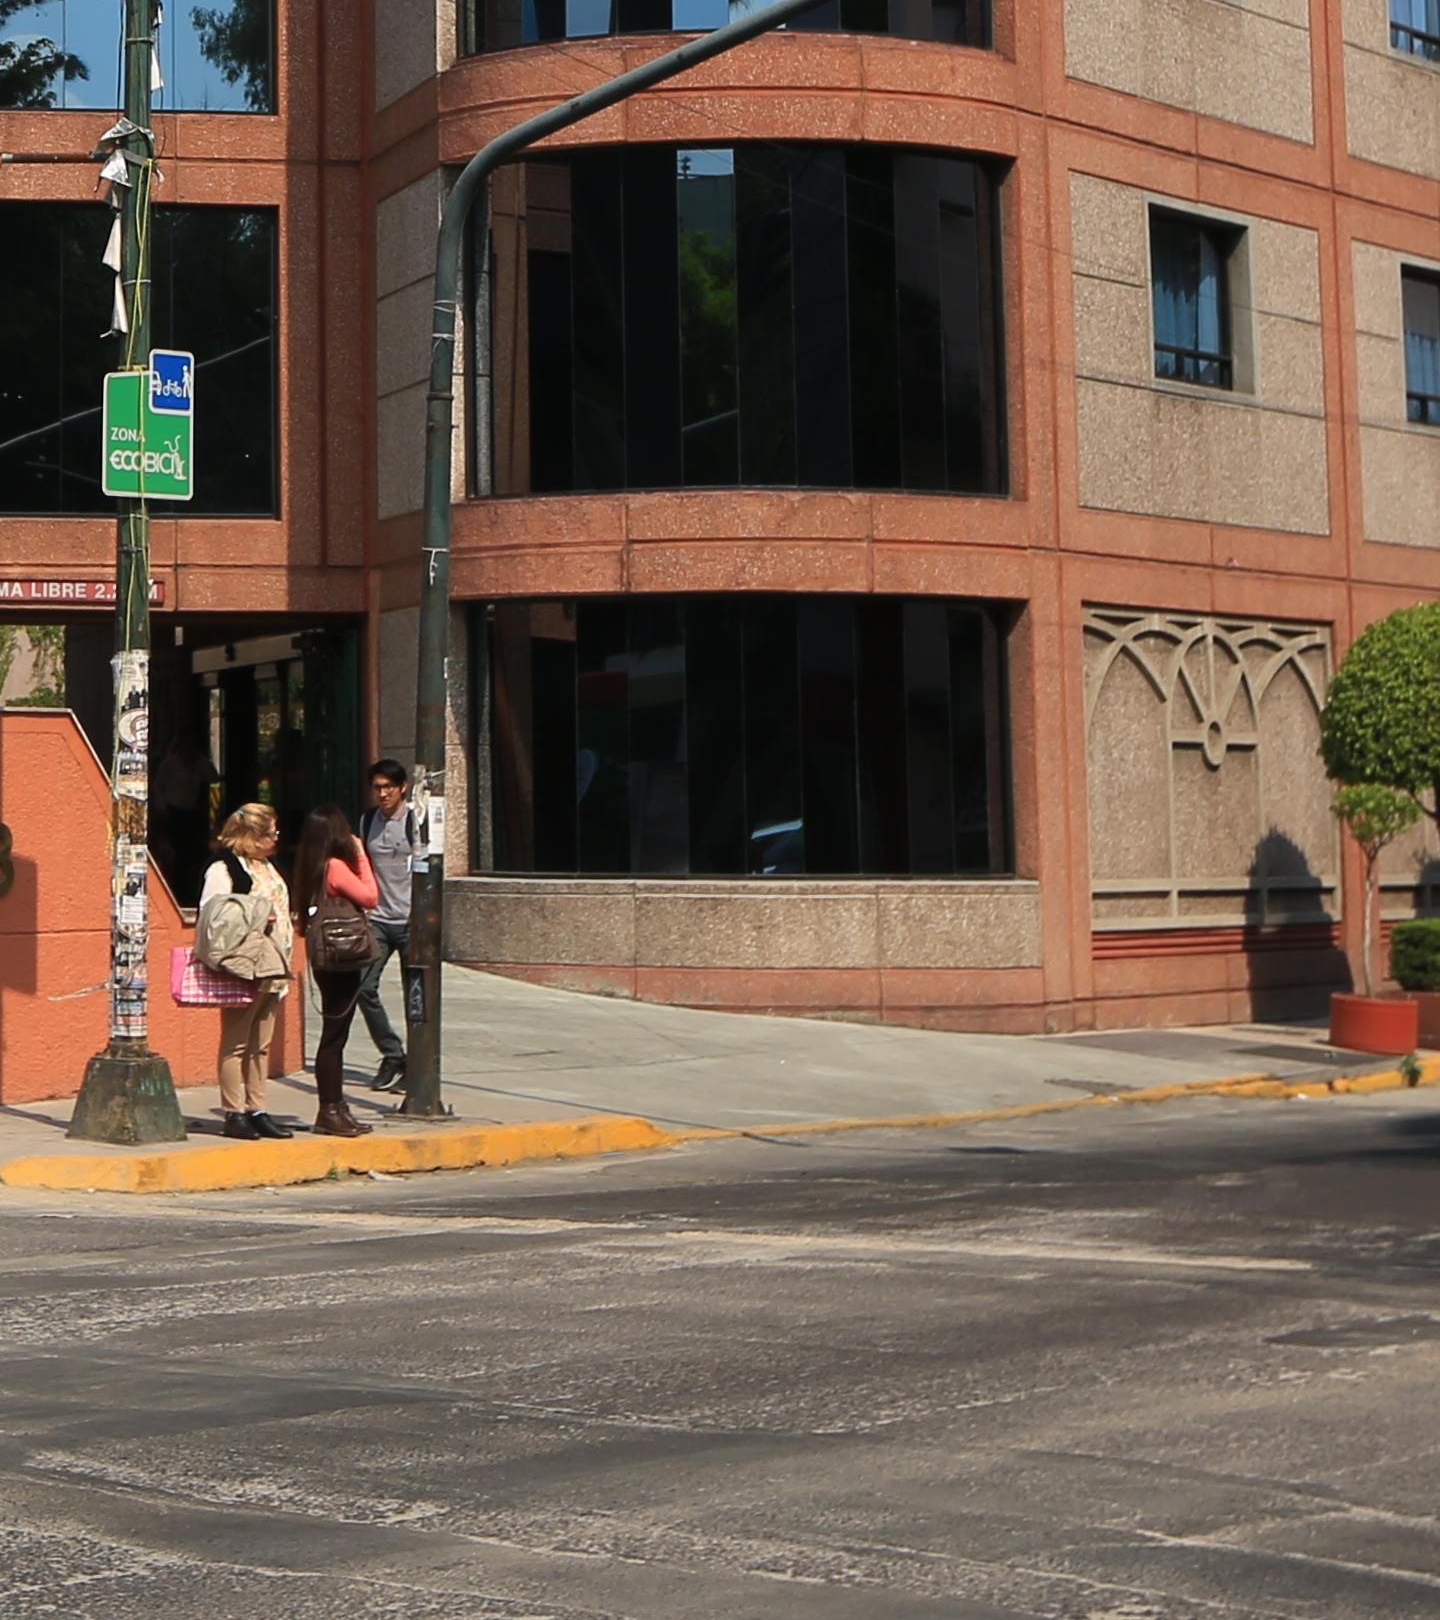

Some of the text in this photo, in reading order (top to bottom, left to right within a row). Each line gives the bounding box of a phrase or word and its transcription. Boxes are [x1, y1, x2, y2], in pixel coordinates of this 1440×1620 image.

[110, 427, 146, 443] ZONA
[109, 448, 180, 477] ECOBICI
[31, 581, 87, 598] LIBRE
